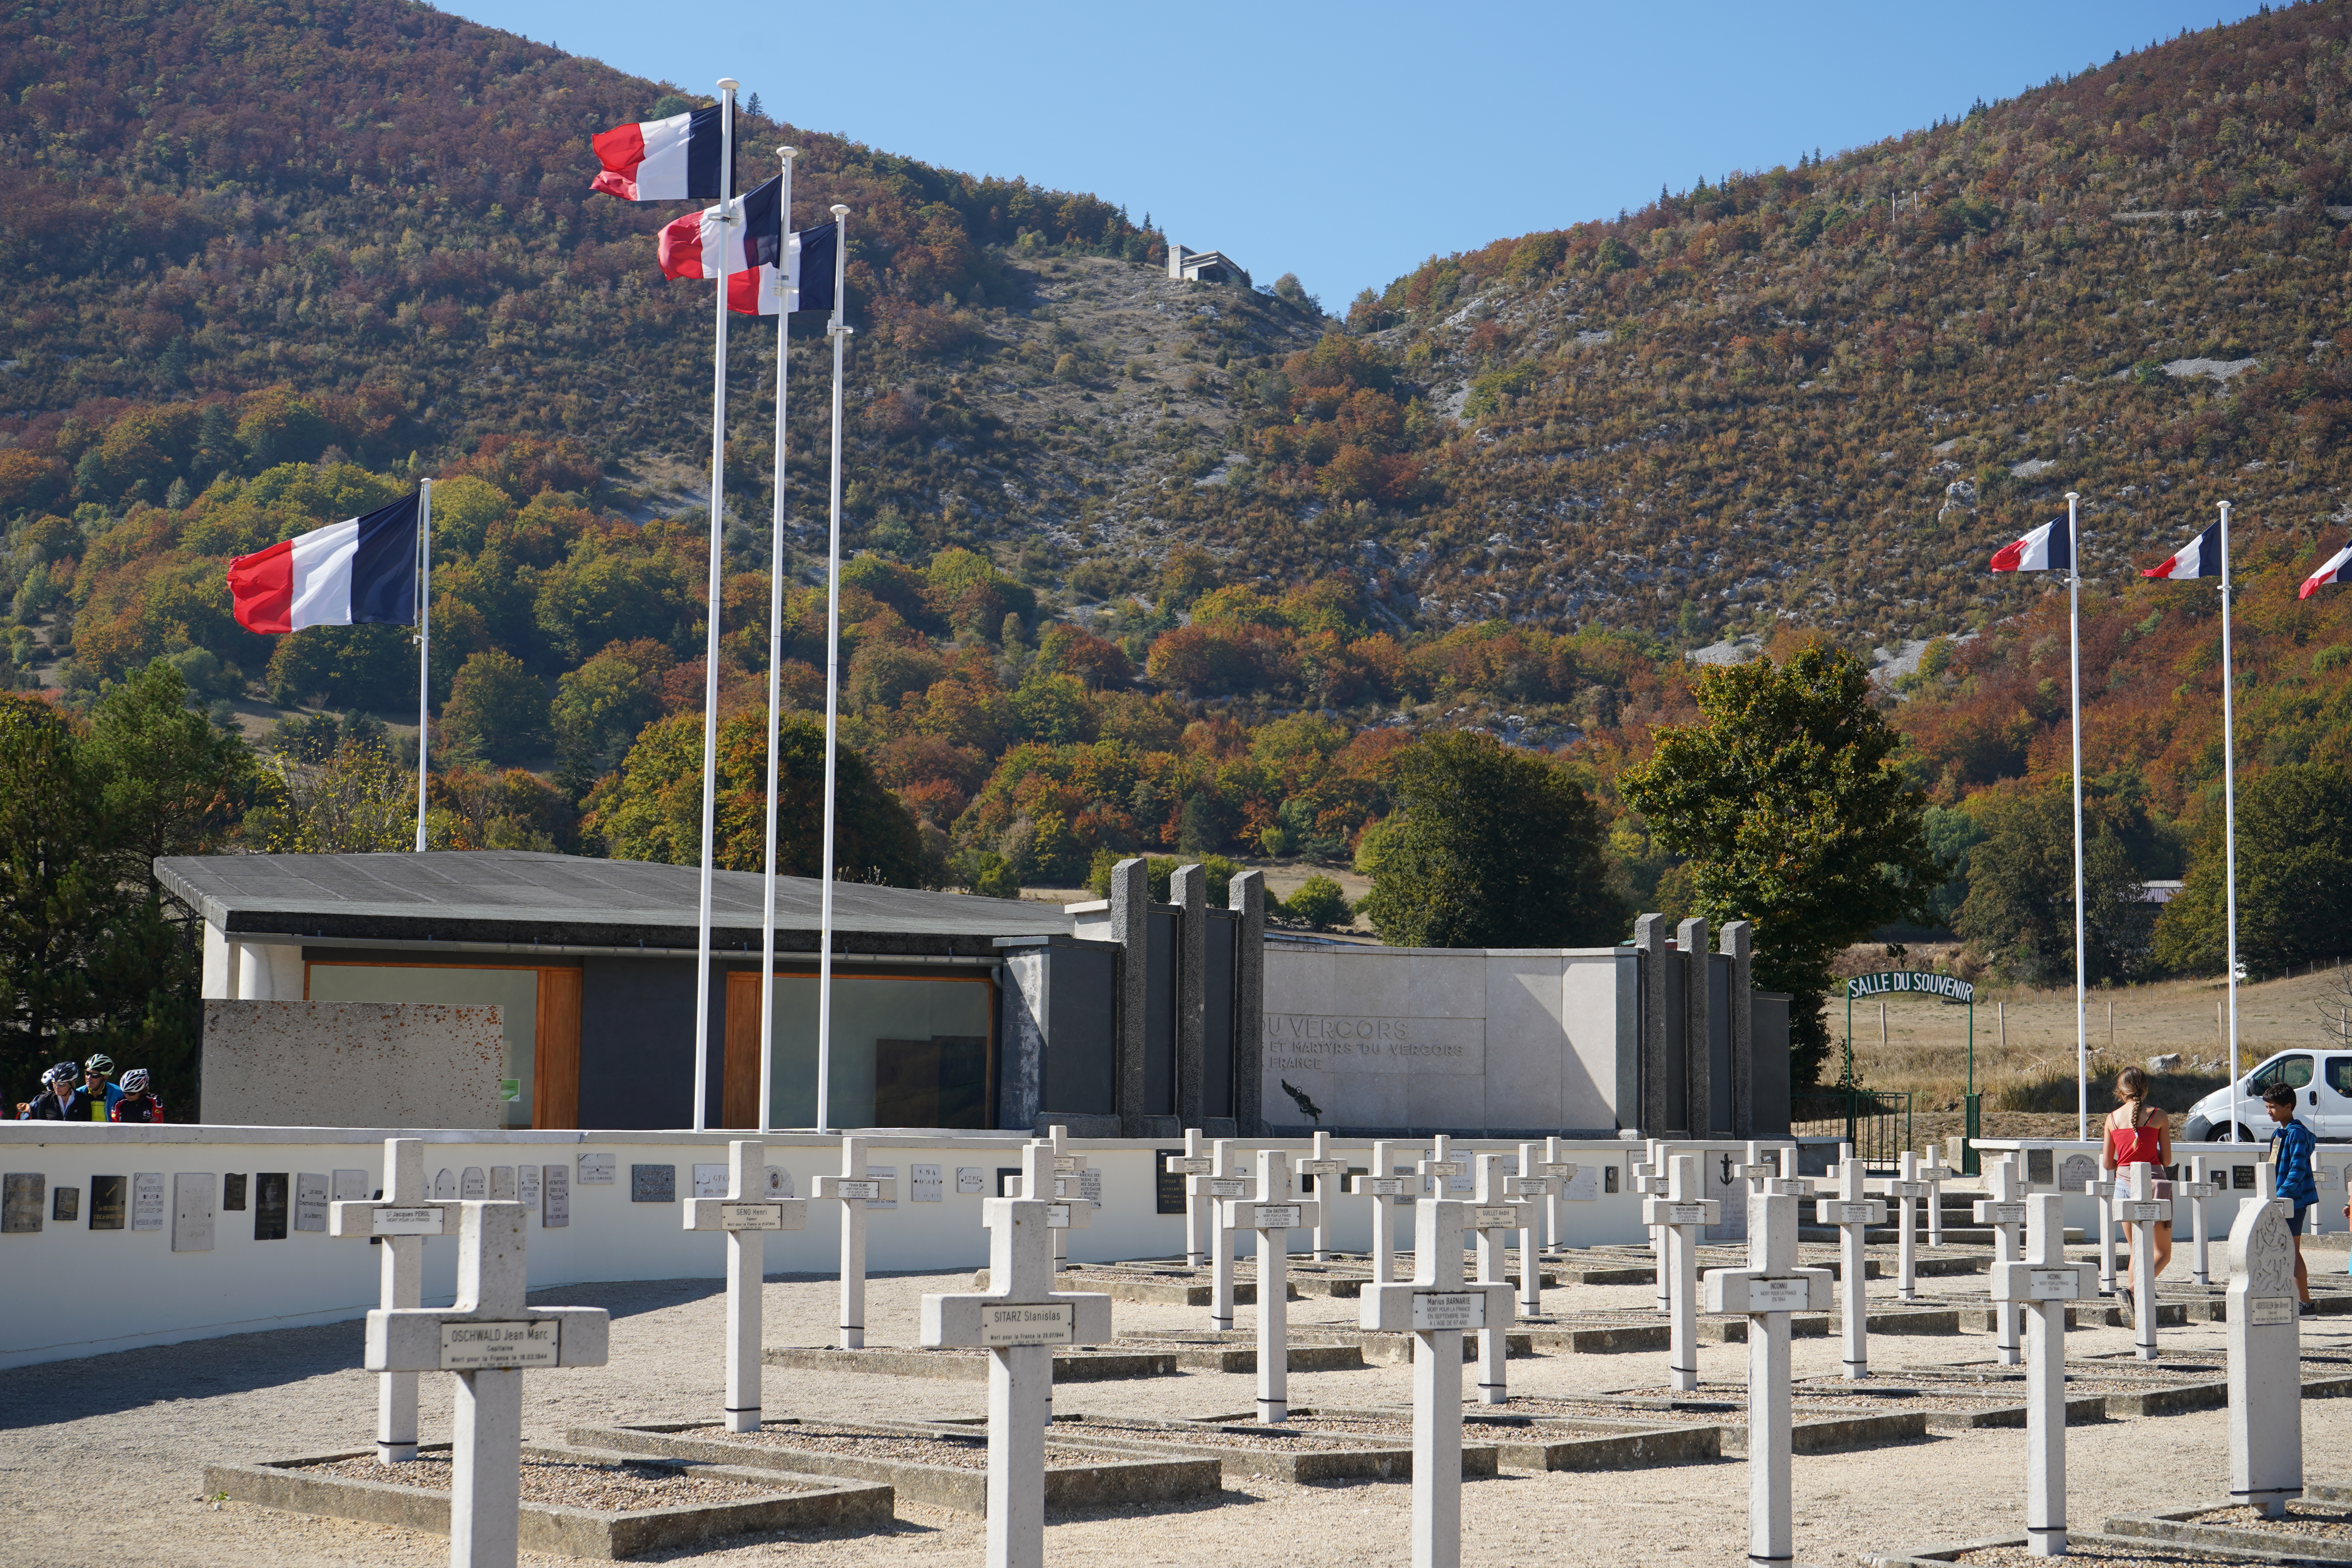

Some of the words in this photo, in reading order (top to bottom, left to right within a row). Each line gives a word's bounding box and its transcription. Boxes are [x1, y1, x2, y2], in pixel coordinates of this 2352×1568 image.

[1849, 973, 1890, 998] SALLE
[1893, 973, 1909, 991] DU
[1913, 973, 1973, 1002] SOUVENIR
[1290, 1017, 1408, 1038] VERCORS
[1271, 1041, 1284, 1052] ET
[1293, 1042, 1352, 1055] MARTYRS
[1360, 1043, 1379, 1054] DU
[1391, 1043, 1463, 1055] VERCORS
[1271, 1057, 1321, 1069] FRANCE
[995, 1310, 1021, 1322] SITARZ
[1024, 1310, 1060, 1321] Stanislas
[451, 1328, 501, 1342] OSCHWALD
[504, 1328, 524, 1340] Jean
[527, 1328, 548, 1339] Marc
